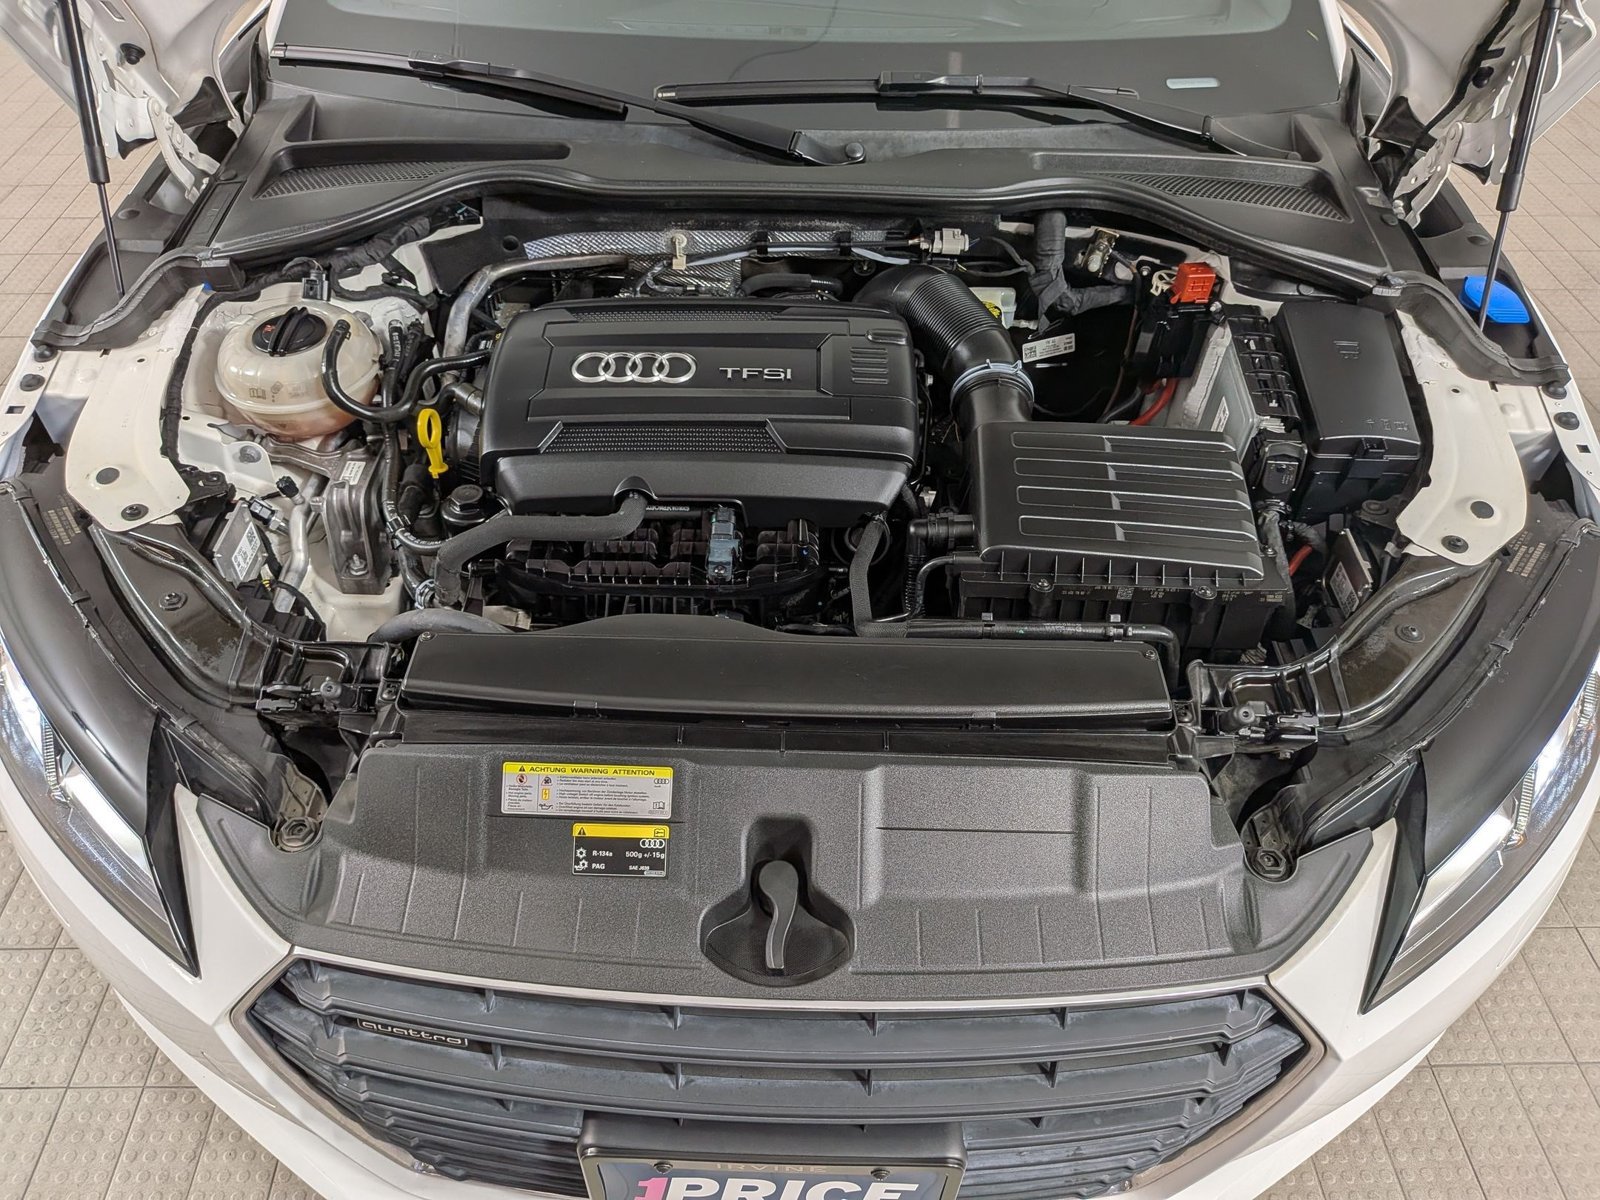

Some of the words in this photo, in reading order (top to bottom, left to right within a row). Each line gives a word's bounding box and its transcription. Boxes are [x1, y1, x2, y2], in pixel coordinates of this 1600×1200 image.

[719, 367, 792, 380] TFSI
[529, 766, 567, 774] ACHTUNG
[570, 767, 609, 775] WARNING
[612, 768, 656, 776] ATTENTION
[625, 851, 643, 859] 500g
[362, 1021, 462, 1044] quattro
[716, 1162, 827, 1173] IRVINE
